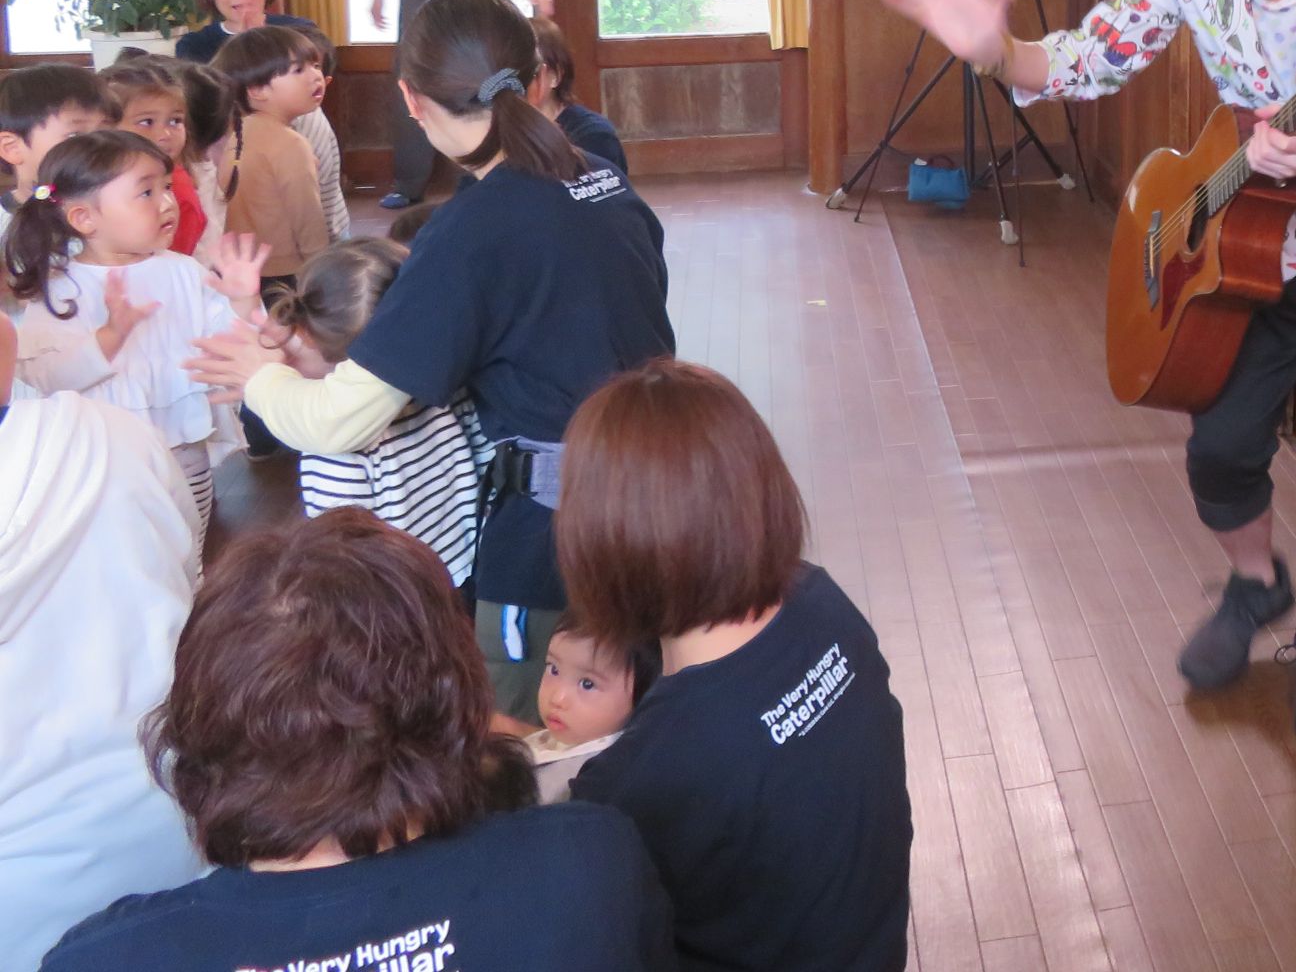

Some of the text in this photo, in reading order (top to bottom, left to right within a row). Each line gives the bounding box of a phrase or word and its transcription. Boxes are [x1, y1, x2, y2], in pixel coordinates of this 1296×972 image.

[760, 703, 786, 727] The
[781, 679, 808, 708] Very
[805, 642, 840, 685] Hungry
[770, 656, 848, 744] Caterpillar
[287, 919, 450, 972] Very Hungry
